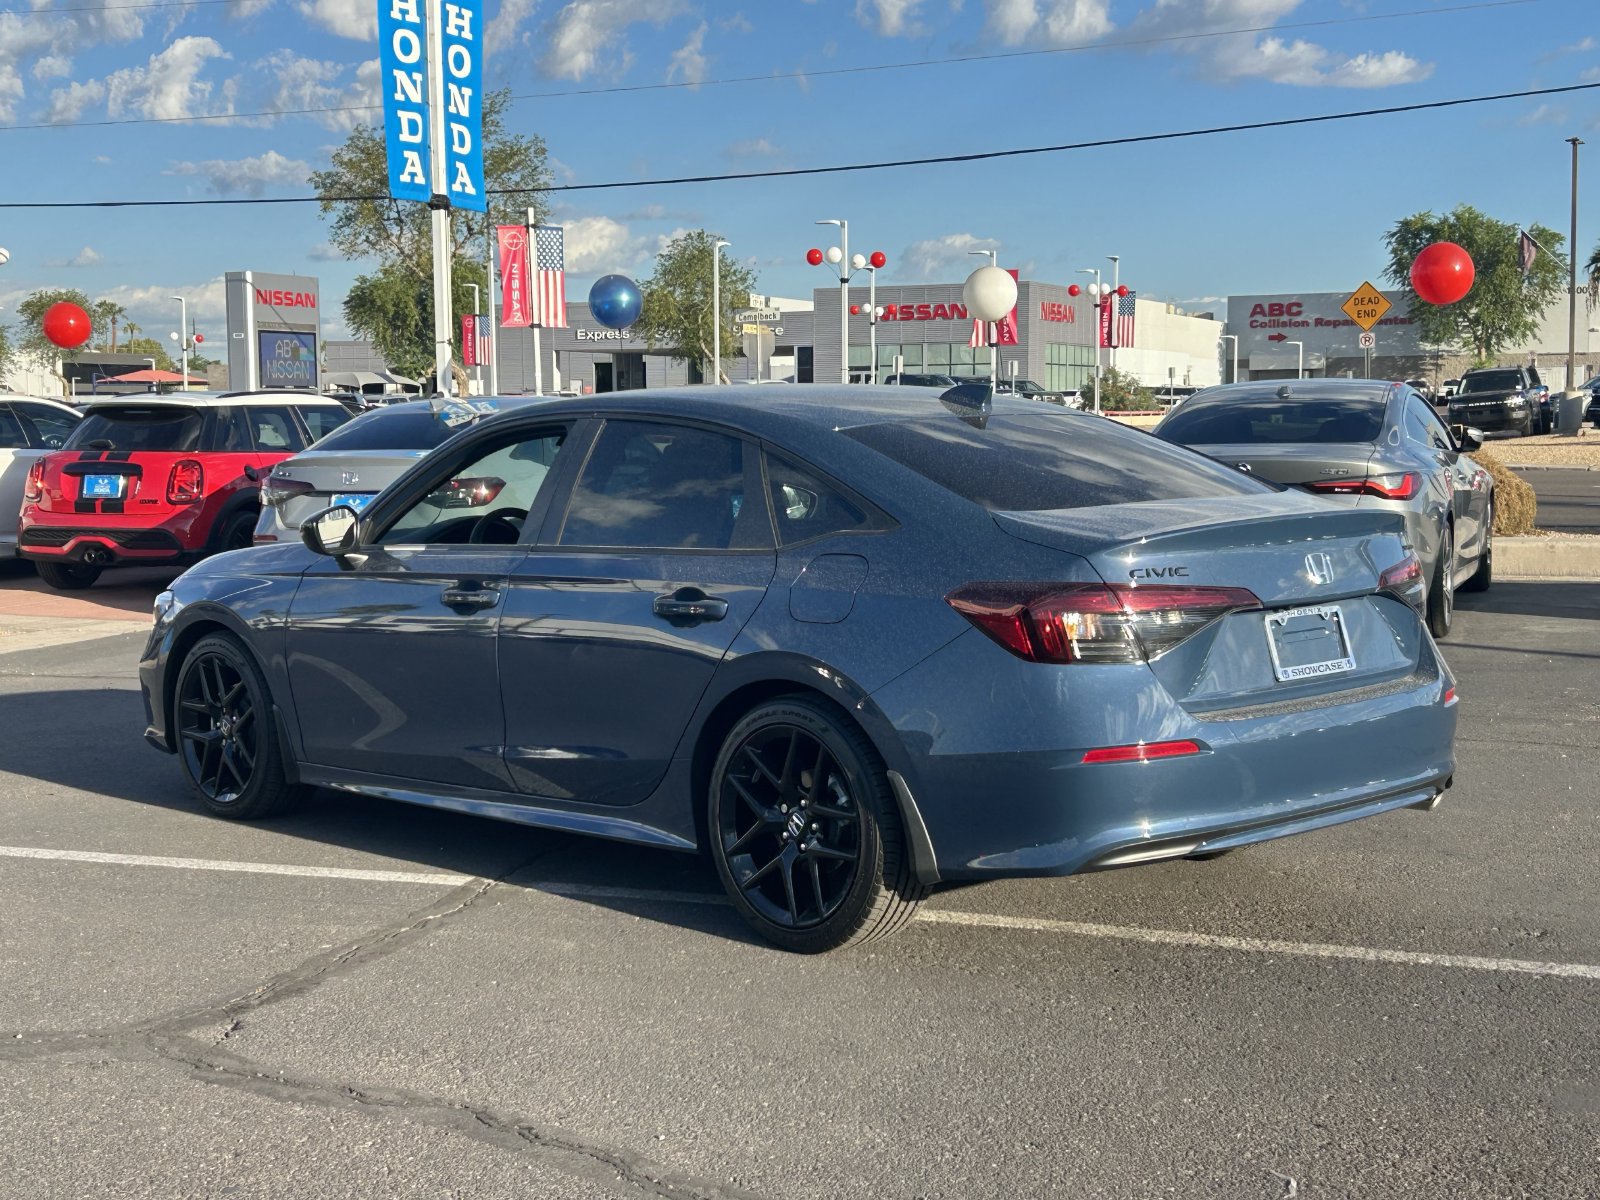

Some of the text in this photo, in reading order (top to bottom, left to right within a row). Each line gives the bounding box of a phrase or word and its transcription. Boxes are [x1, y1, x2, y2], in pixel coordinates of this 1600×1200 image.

[390, 0, 426, 185] HONDA
[446, 3, 477, 196] HONDA
[256, 288, 316, 309] NISSAN
[511, 263, 524, 322] NISSAN
[1353, 297, 1380, 306] DEAD
[738, 312, 778, 322] Camelback
[1040, 302, 1075, 323] NISSAN
[1249, 302, 1304, 317] ABC
[1356, 310, 1377, 318] END
[1249, 319, 1310, 328] Collision
[1377, 316, 1413, 325] enter
[576, 329, 630, 341] Express
[267, 360, 310, 380] NISSAN
[1129, 566, 1189, 578] CIVIC
[1291, 661, 1344, 677] SHOWCASE
